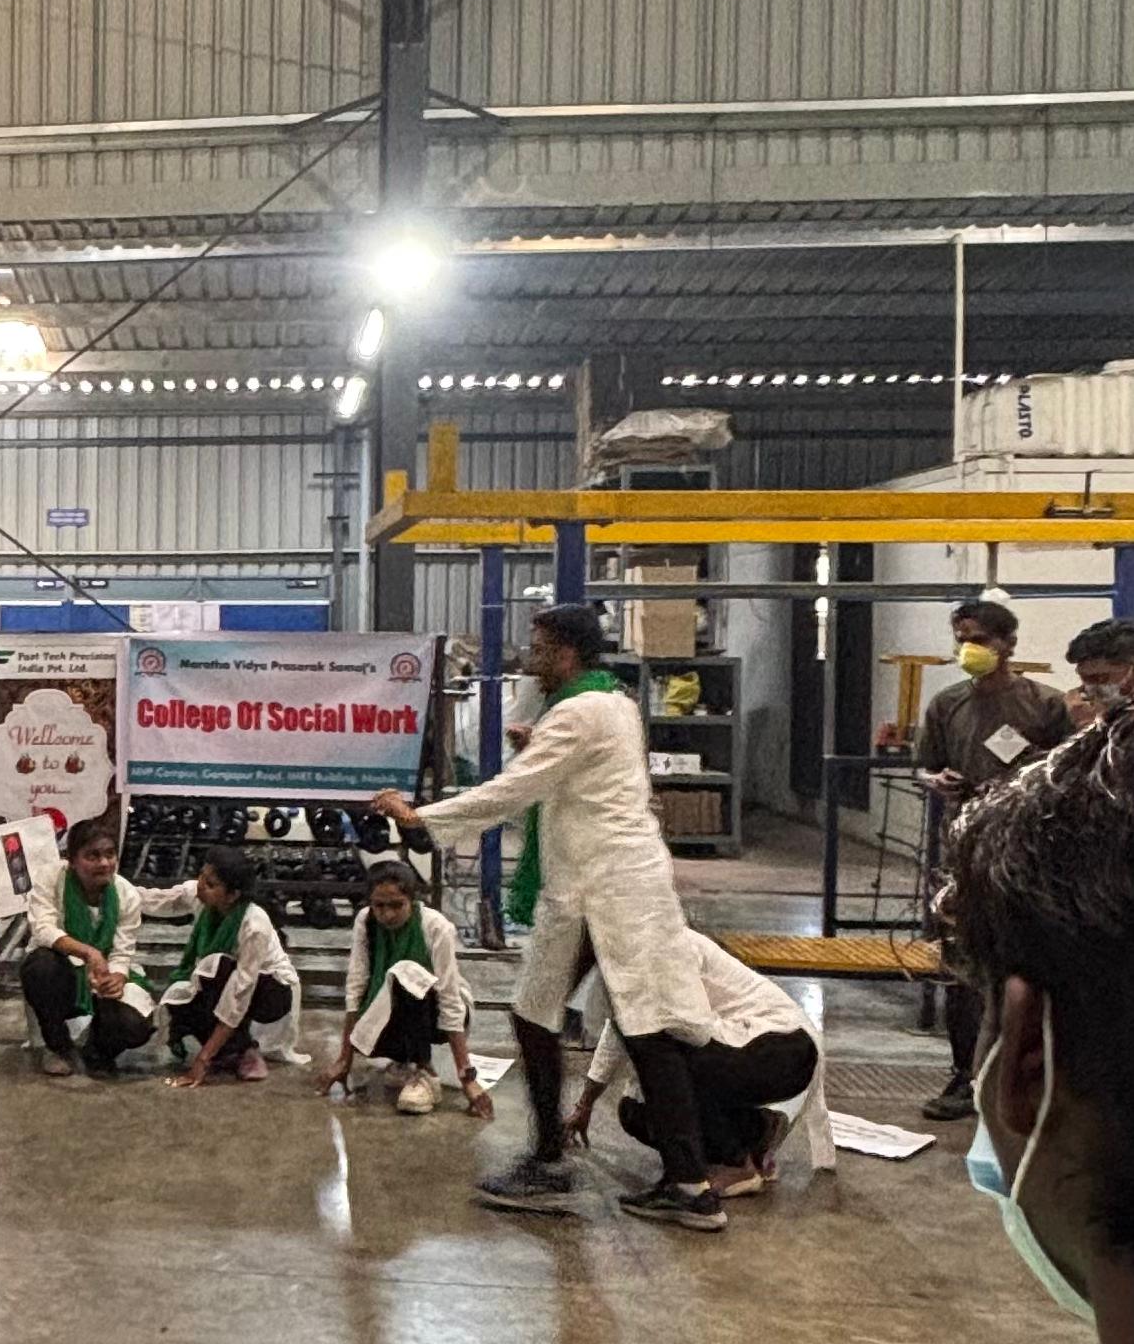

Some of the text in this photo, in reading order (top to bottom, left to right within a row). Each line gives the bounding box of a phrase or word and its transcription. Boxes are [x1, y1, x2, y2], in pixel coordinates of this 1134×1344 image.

[43, 651, 66, 661] Tech
[18, 664, 44, 673] India
[180, 659, 377, 675] Maratha Vidya Prasarak Samaj's
[137, 698, 419, 734] College Of Social Work
[42, 756, 60, 770] to
